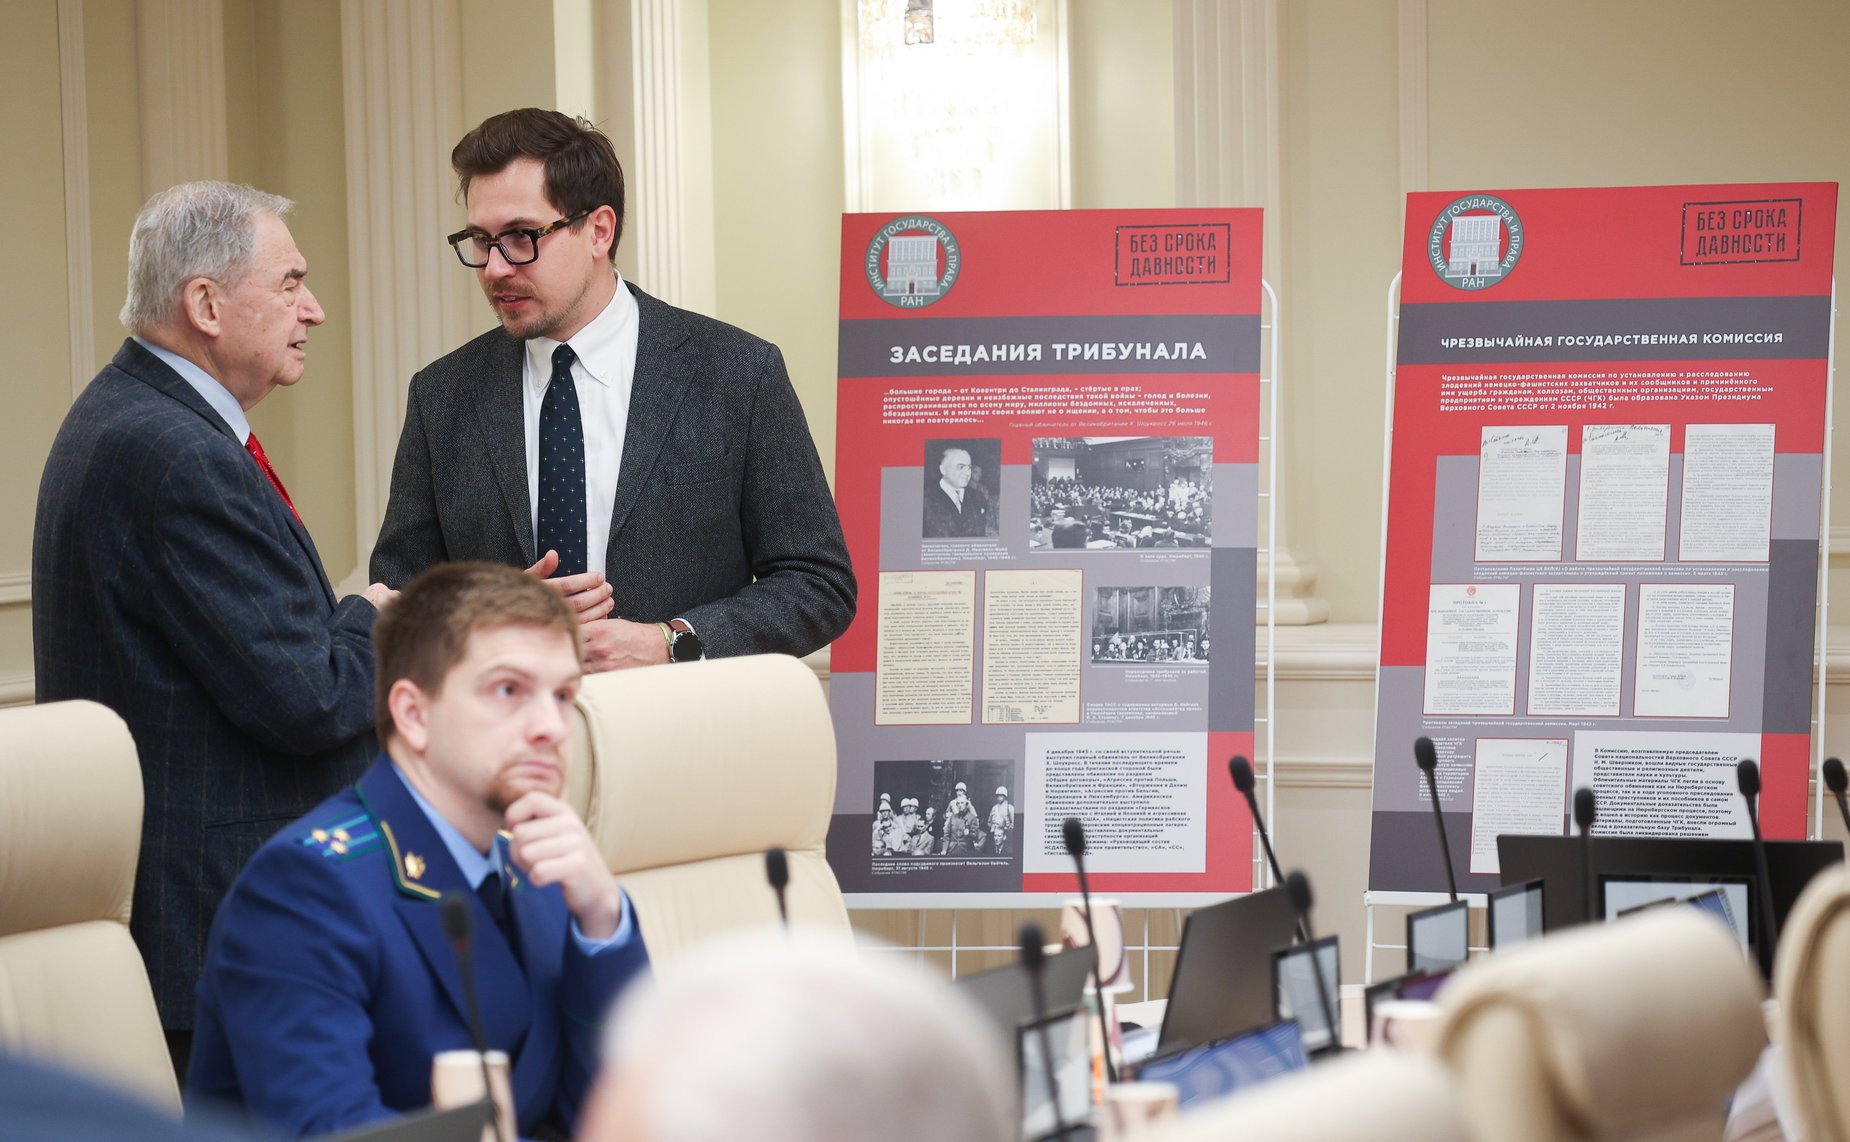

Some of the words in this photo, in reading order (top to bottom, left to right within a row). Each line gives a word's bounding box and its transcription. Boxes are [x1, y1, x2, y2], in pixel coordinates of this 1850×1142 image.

[1697, 211, 1726, 230] БЕЗ
[1732, 209, 1786, 228] СРОКА
[884, 219, 949, 244] ГОСУДАРСТВА
[1432, 216, 1448, 271] ИНСТИТУТ
[1447, 198, 1514, 223] ГОСУДАРСТВА
[1502, 235, 1520, 268] ПРАВА
[946, 245, 955, 253] И
[1130, 234, 1158, 252] БЕЗ
[1164, 233, 1216, 251] СРОКА
[1696, 234, 1786, 256] ДАВНОСТИ
[869, 237, 884, 290] ИНСТИТУТ
[940, 256, 956, 287] ПРАВА
[1130, 256, 1216, 277] ДАВНОСТИ
[1462, 278, 1485, 287] РАН
[901, 296, 923, 306] РАН
[1441, 337, 1552, 347] ЧРЕЗВЫЧАЙНАЯ
[1558, 335, 1697, 345] ГОСУДАРСТВЕННАЯ
[1703, 334, 1782, 343] КОМИССИЯ
[890, 345, 1042, 363] ЗАСЕДАНИЯ
[1052, 343, 1206, 359] ТРИБУНАЛА
